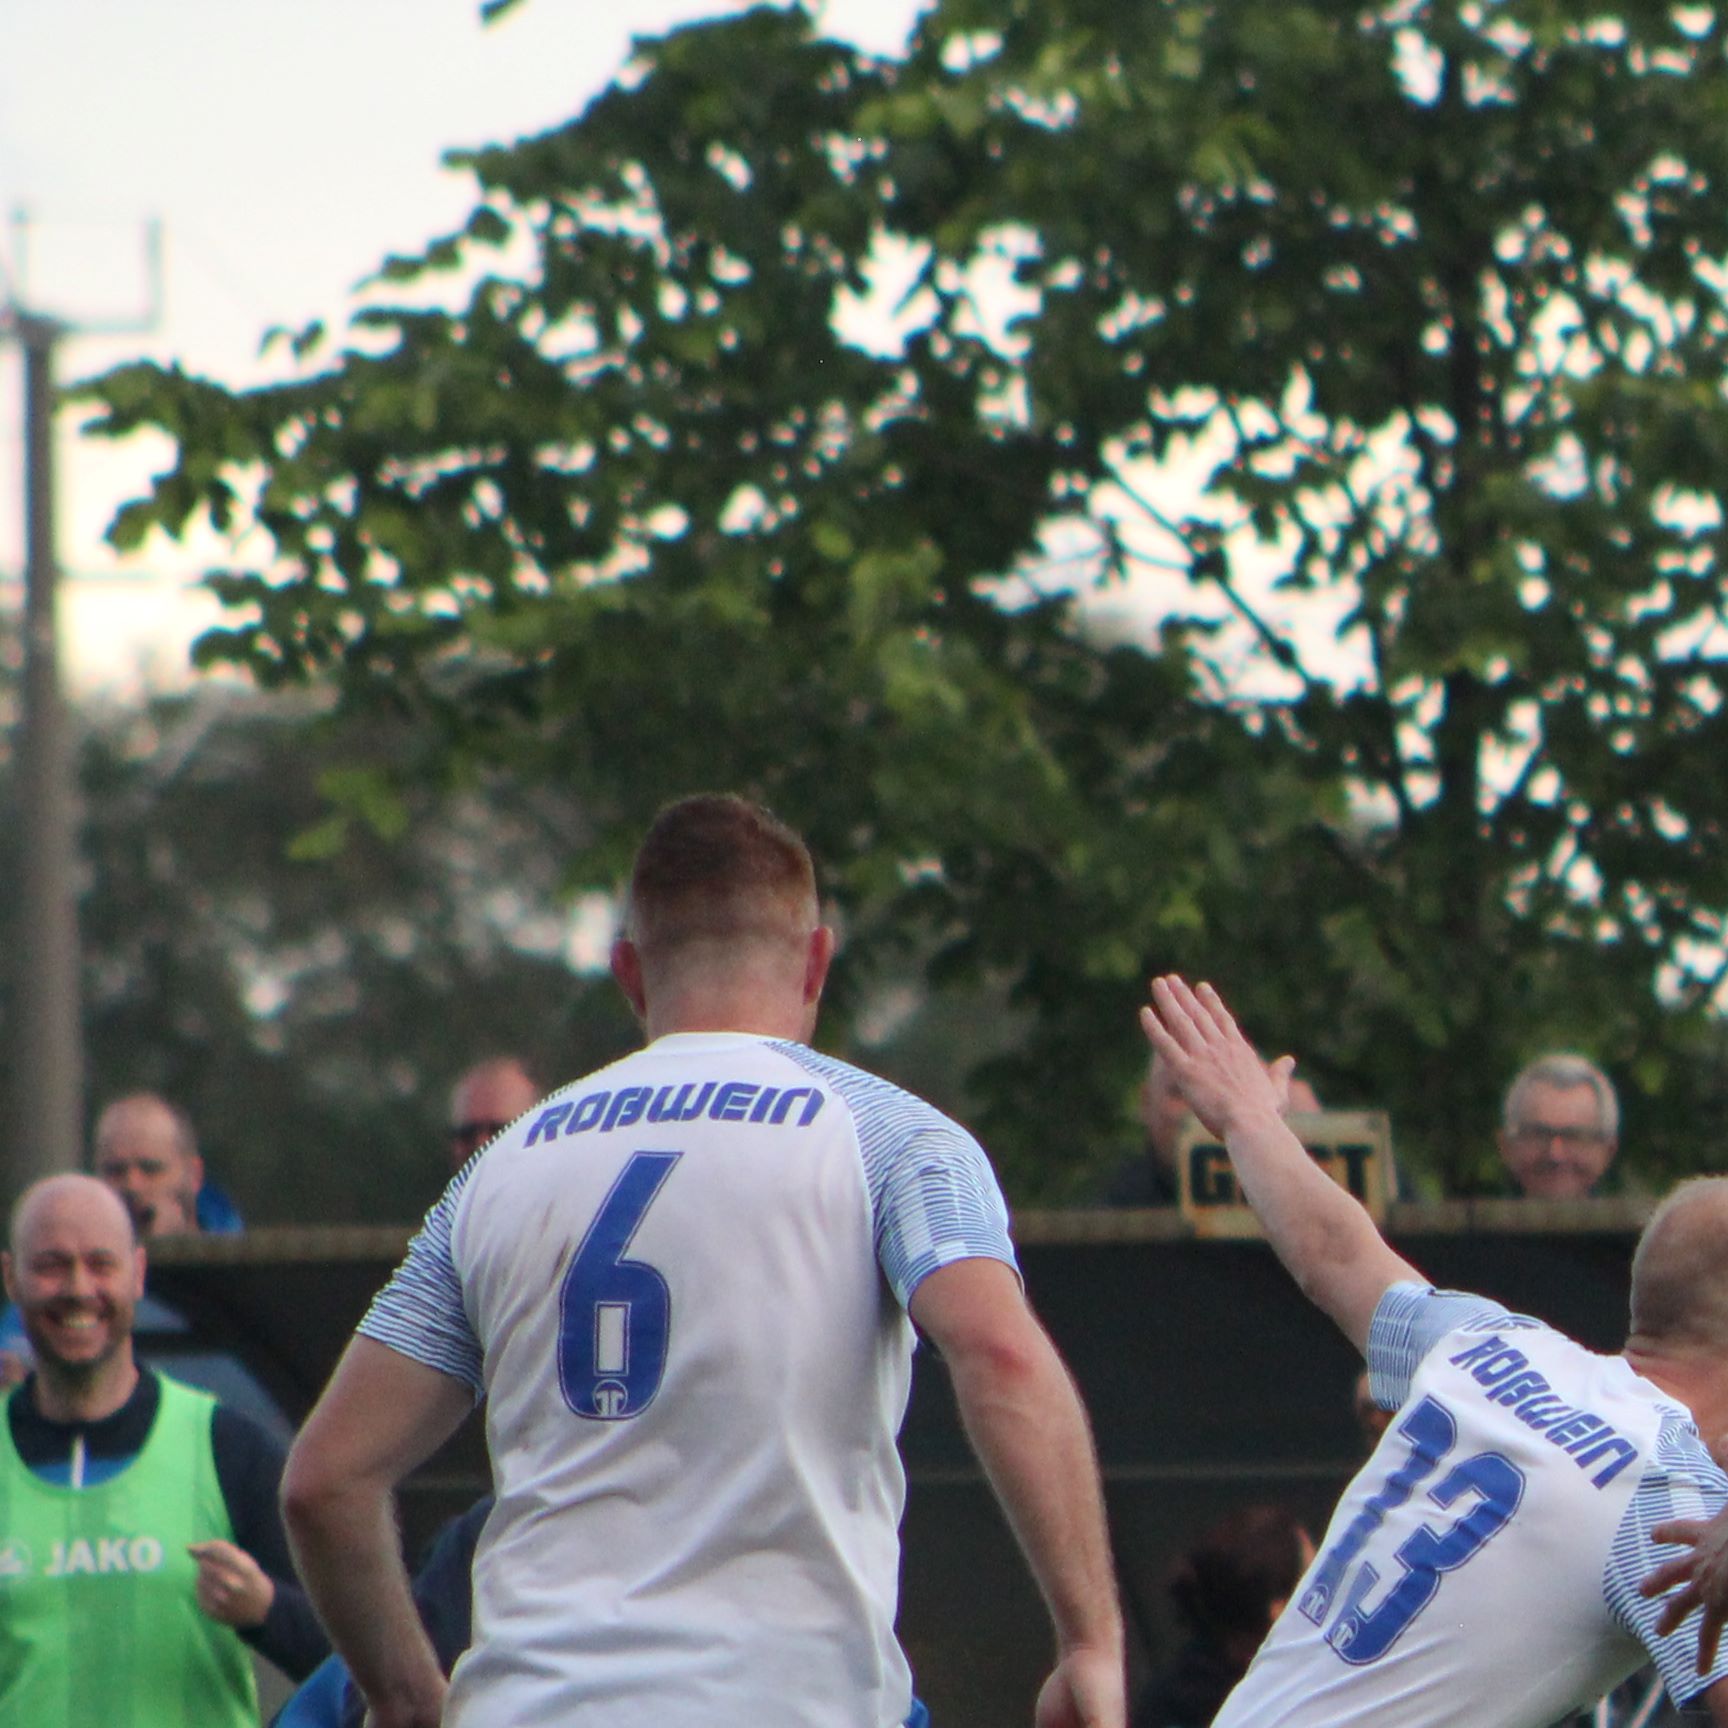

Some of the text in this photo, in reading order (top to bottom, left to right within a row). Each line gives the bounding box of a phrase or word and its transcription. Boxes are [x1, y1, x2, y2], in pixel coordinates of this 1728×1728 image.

[1189, 1144, 1374, 1206] GT
[557, 1149, 685, 1421] 6
[44, 1536, 164, 1576] JAKO
[1297, 1394, 1527, 1666] 13
